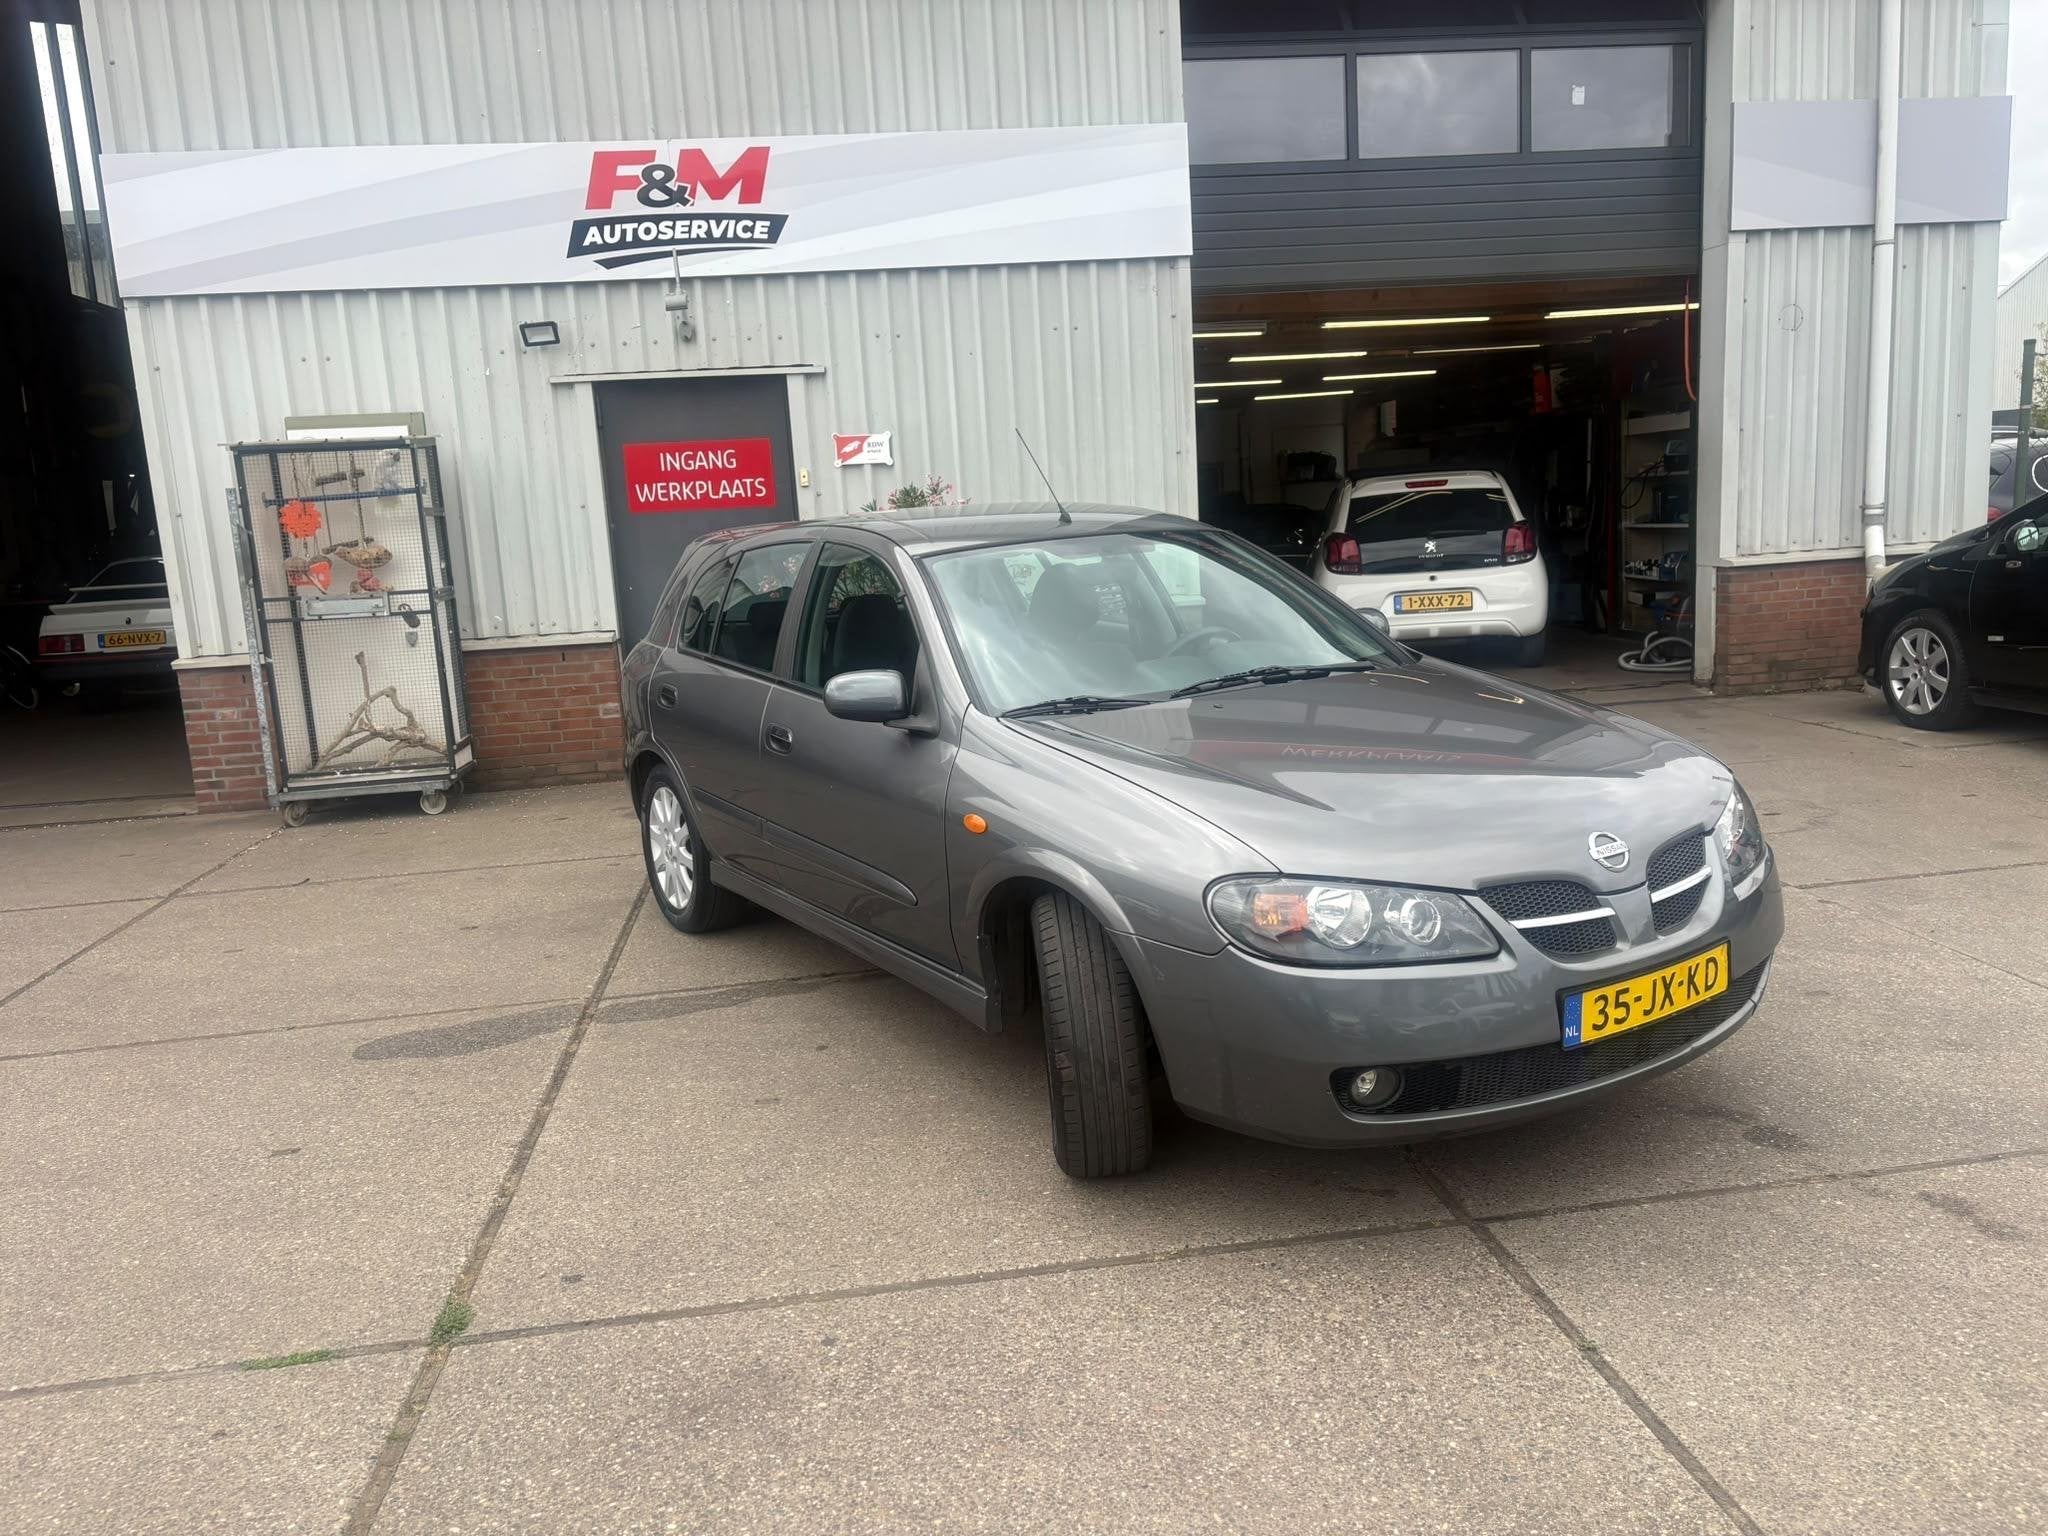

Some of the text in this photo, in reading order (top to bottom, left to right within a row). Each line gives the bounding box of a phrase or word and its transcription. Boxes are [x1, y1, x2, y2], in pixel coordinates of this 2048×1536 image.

[585, 146, 771, 210] F&M
[582, 219, 771, 246] AUTOSERVICE
[659, 449, 737, 472] INGANG
[635, 477, 767, 503] WERKPLAATS
[1408, 594, 1465, 609] 1-XXX-72
[108, 632, 161, 645] 66-NVX-7
[1596, 841, 1627, 856] NISSAN
[1591, 956, 1719, 1032] 35-JX-KD
[1565, 1026, 1579, 1038] NL
